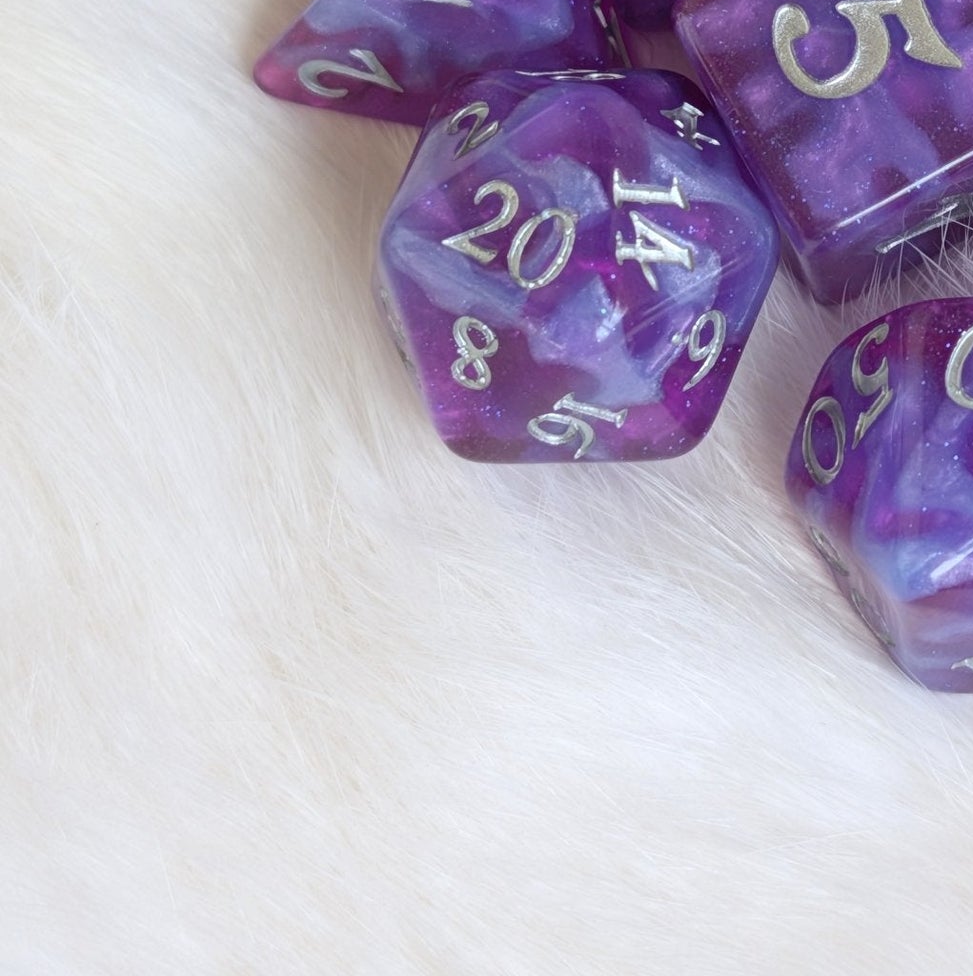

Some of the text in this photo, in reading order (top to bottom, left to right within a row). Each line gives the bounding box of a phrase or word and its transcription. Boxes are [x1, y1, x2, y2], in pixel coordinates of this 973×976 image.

[299, 49, 404, 99] 2
[446, 101, 499, 161] 2
[441, 180, 576, 290] 20
[612, 167, 695, 291] 14
[450, 315, 499, 391] 8
[526, 392, 628, 460] 16
[802, 322, 893, 485] 50
